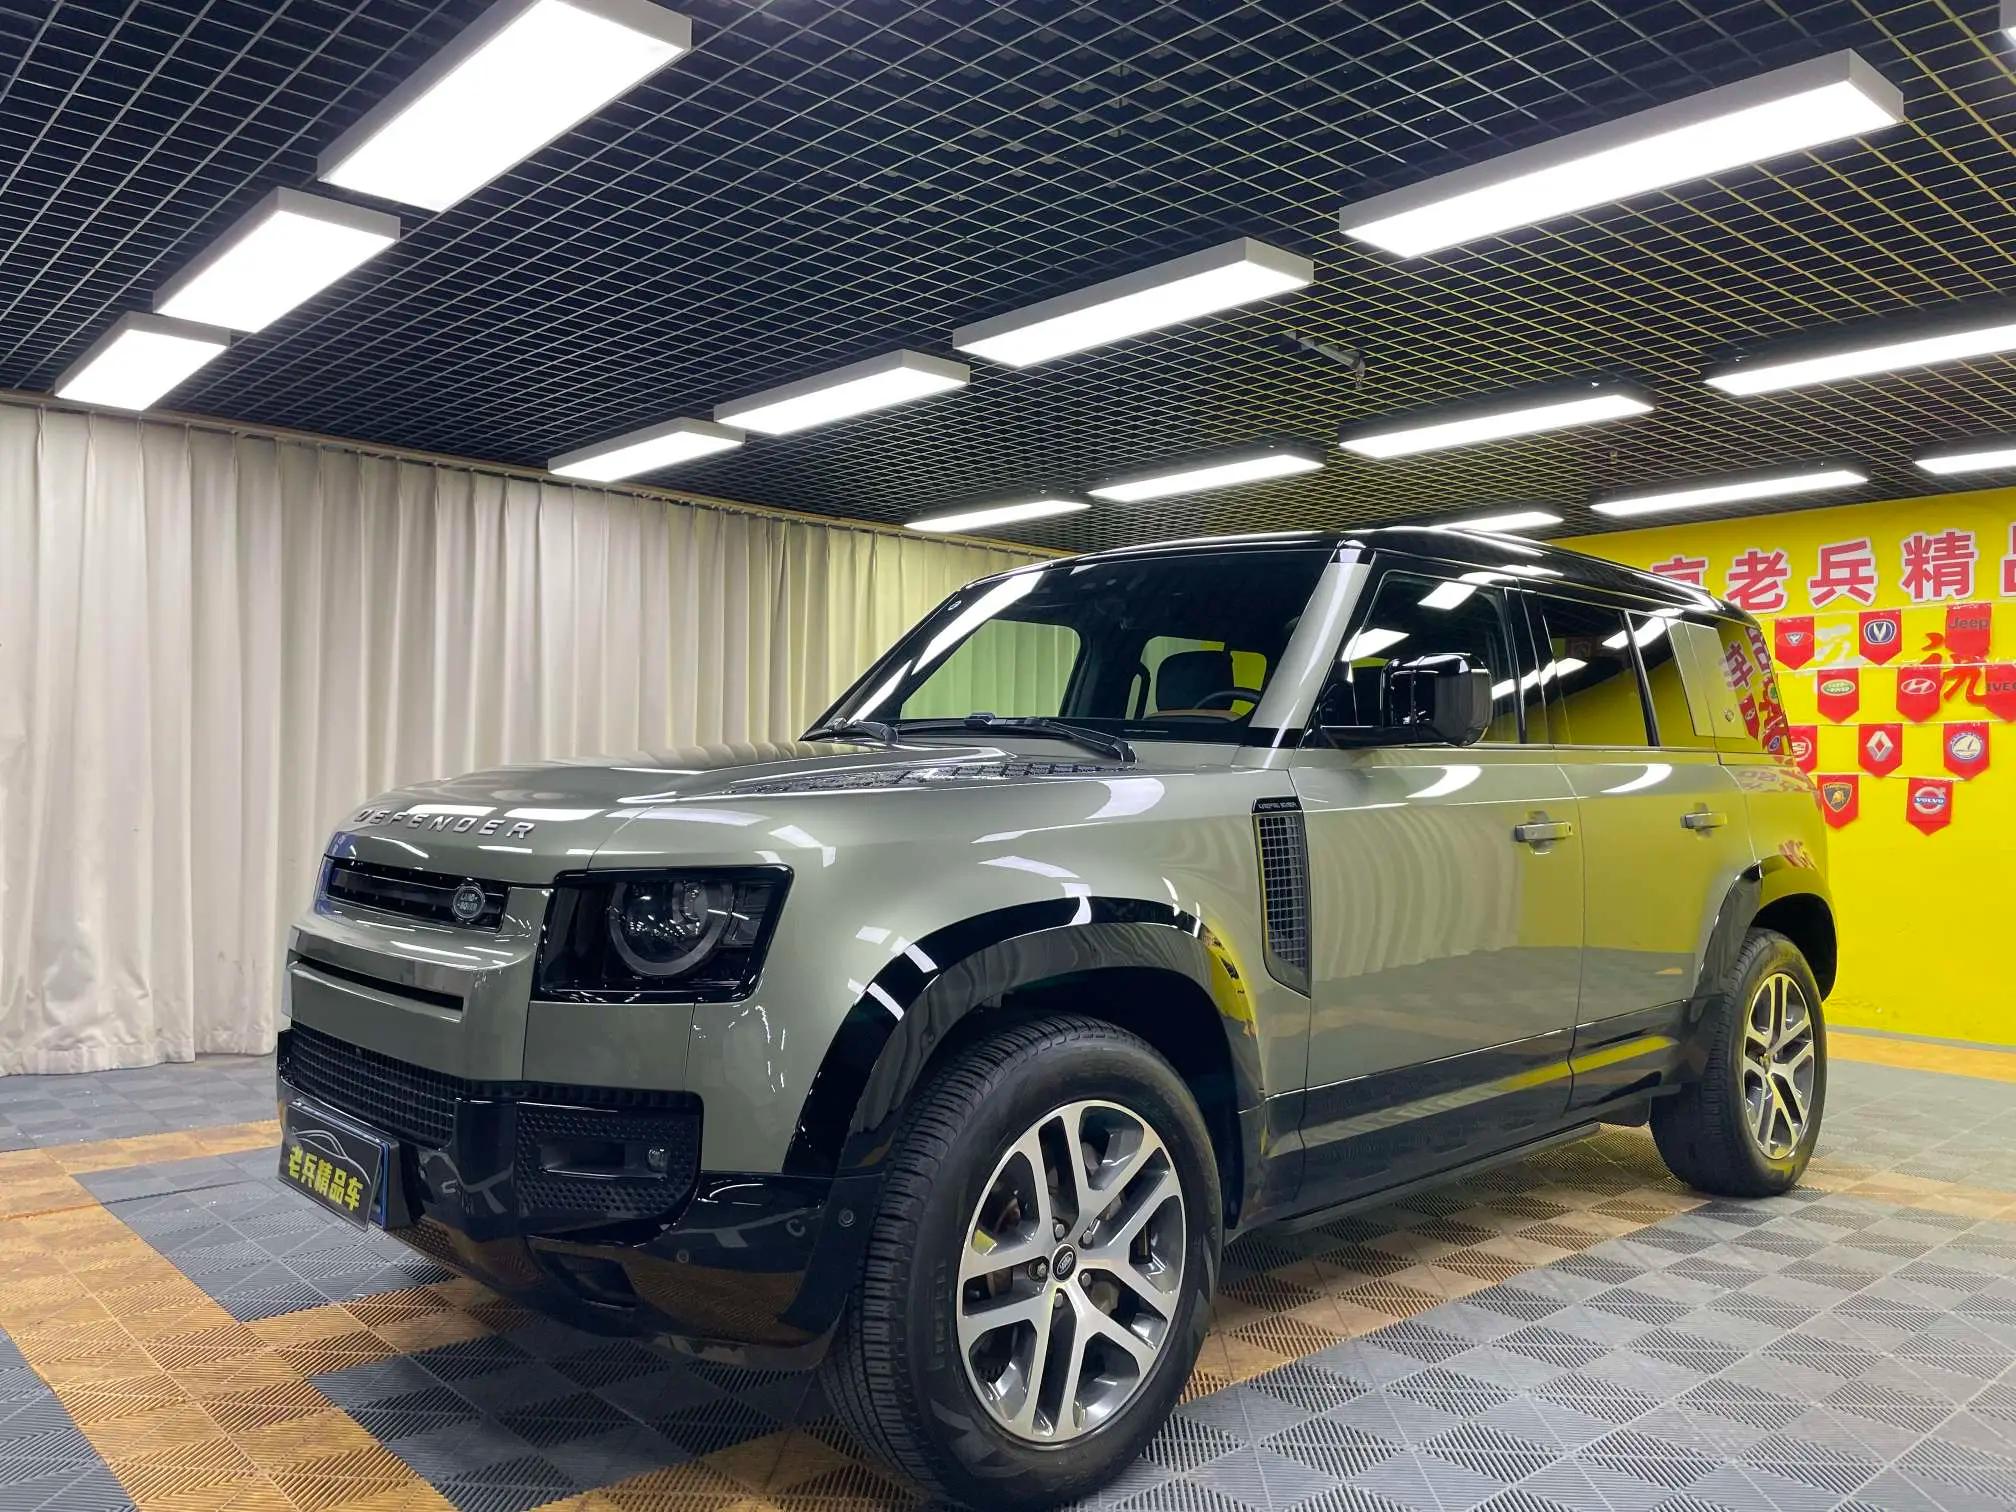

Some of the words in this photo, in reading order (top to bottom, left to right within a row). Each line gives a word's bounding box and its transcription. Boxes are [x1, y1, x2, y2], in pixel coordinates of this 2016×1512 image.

[1652, 524, 2016, 612] 老兵精
[1948, 616, 1990, 631] Jeep
[354, 809, 536, 839] DEFENDER
[288, 1144, 363, 1212] 老兵精品车
